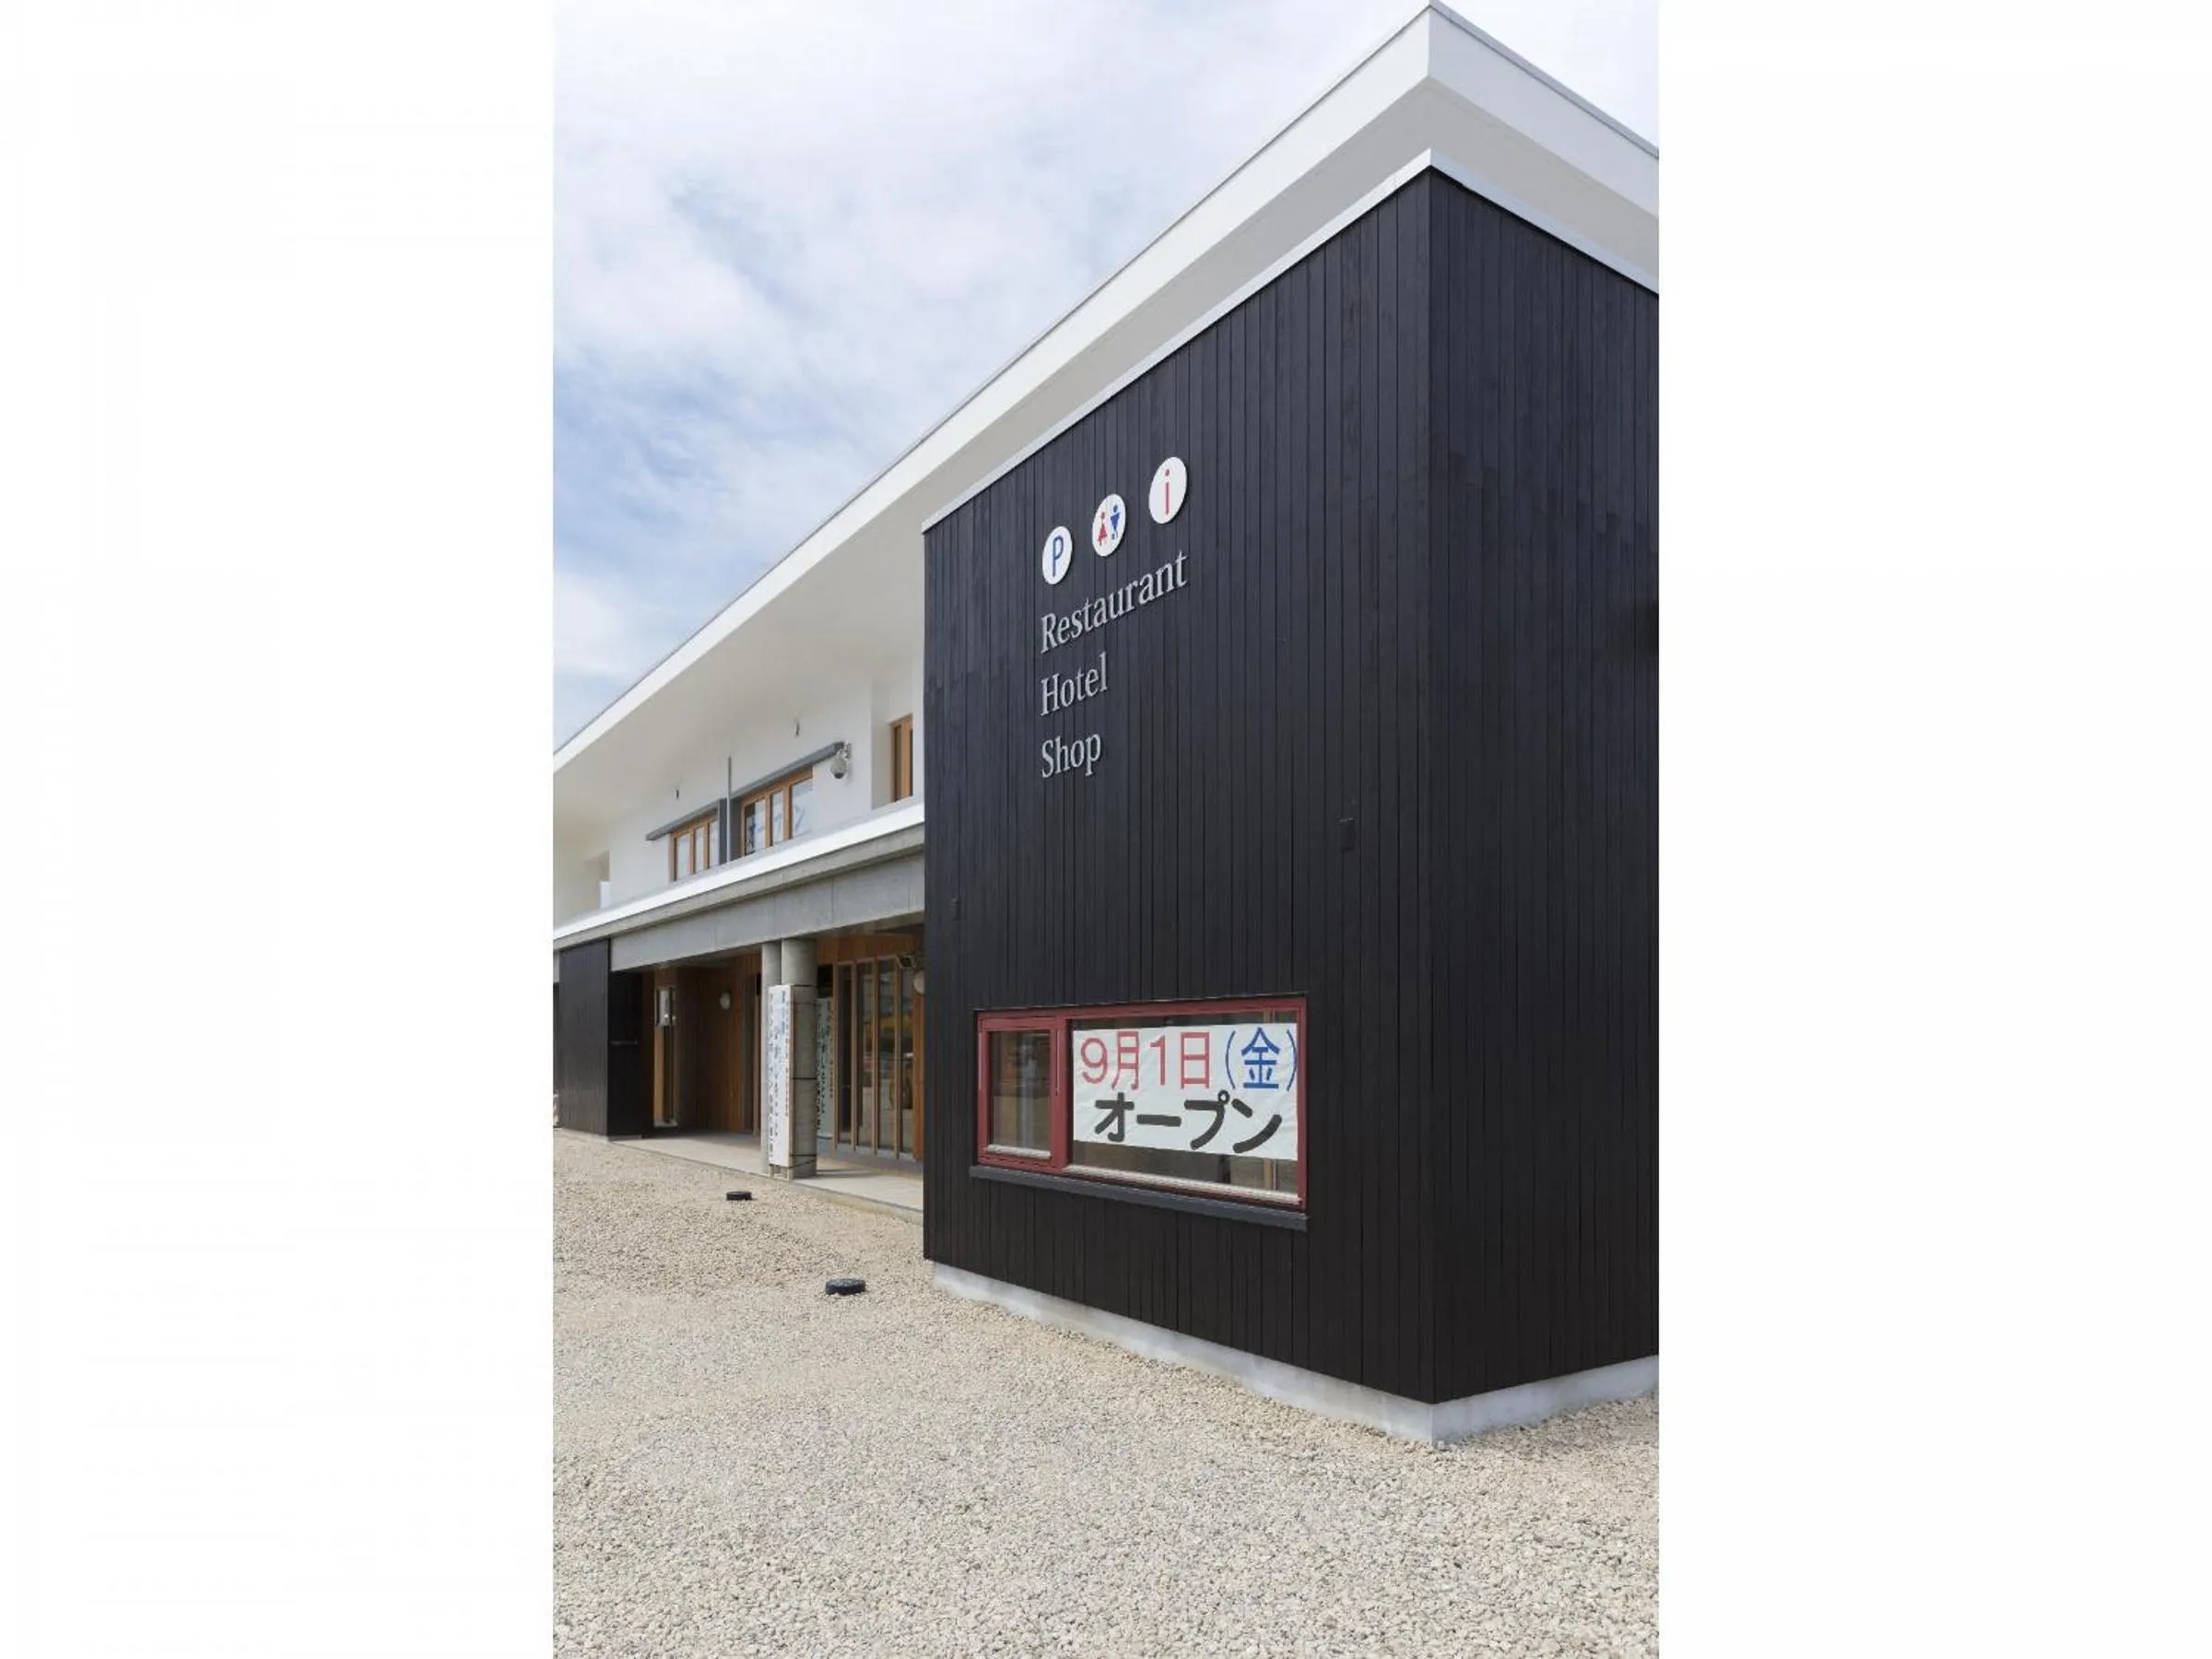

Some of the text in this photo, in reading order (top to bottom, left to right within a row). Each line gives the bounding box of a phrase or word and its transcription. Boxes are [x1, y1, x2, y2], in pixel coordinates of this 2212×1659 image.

[1052, 535, 1065, 578] P
[1041, 550, 1188, 654] Restaurant
[1041, 652, 1109, 716] Hotel
[1041, 734, 1102, 779] Shop
[1079, 1027, 1297, 1091] 9月1日(金)
[1094, 1089, 1282, 1153] オープン
